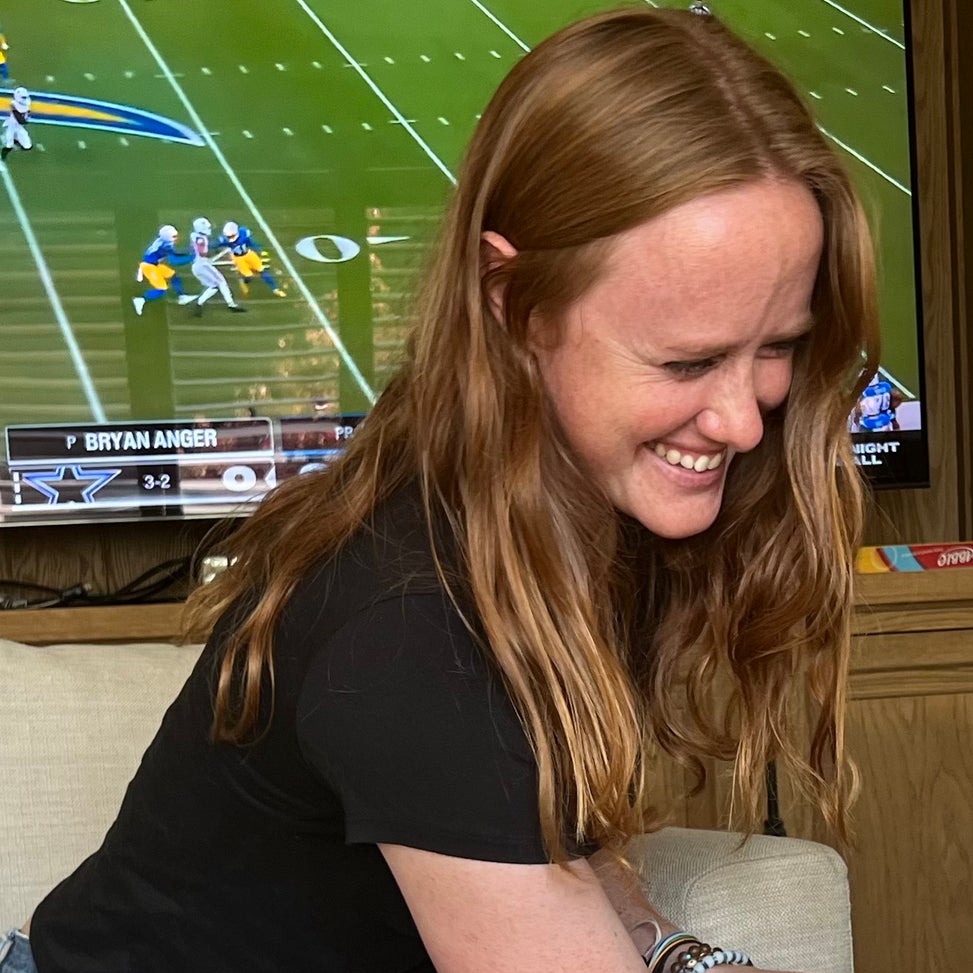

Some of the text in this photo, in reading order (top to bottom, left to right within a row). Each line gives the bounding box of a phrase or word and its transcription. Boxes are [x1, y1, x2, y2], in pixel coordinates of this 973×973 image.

[67, 428, 218, 451] P BRYAN ANGER
[143, 474, 171, 490] 3-2
